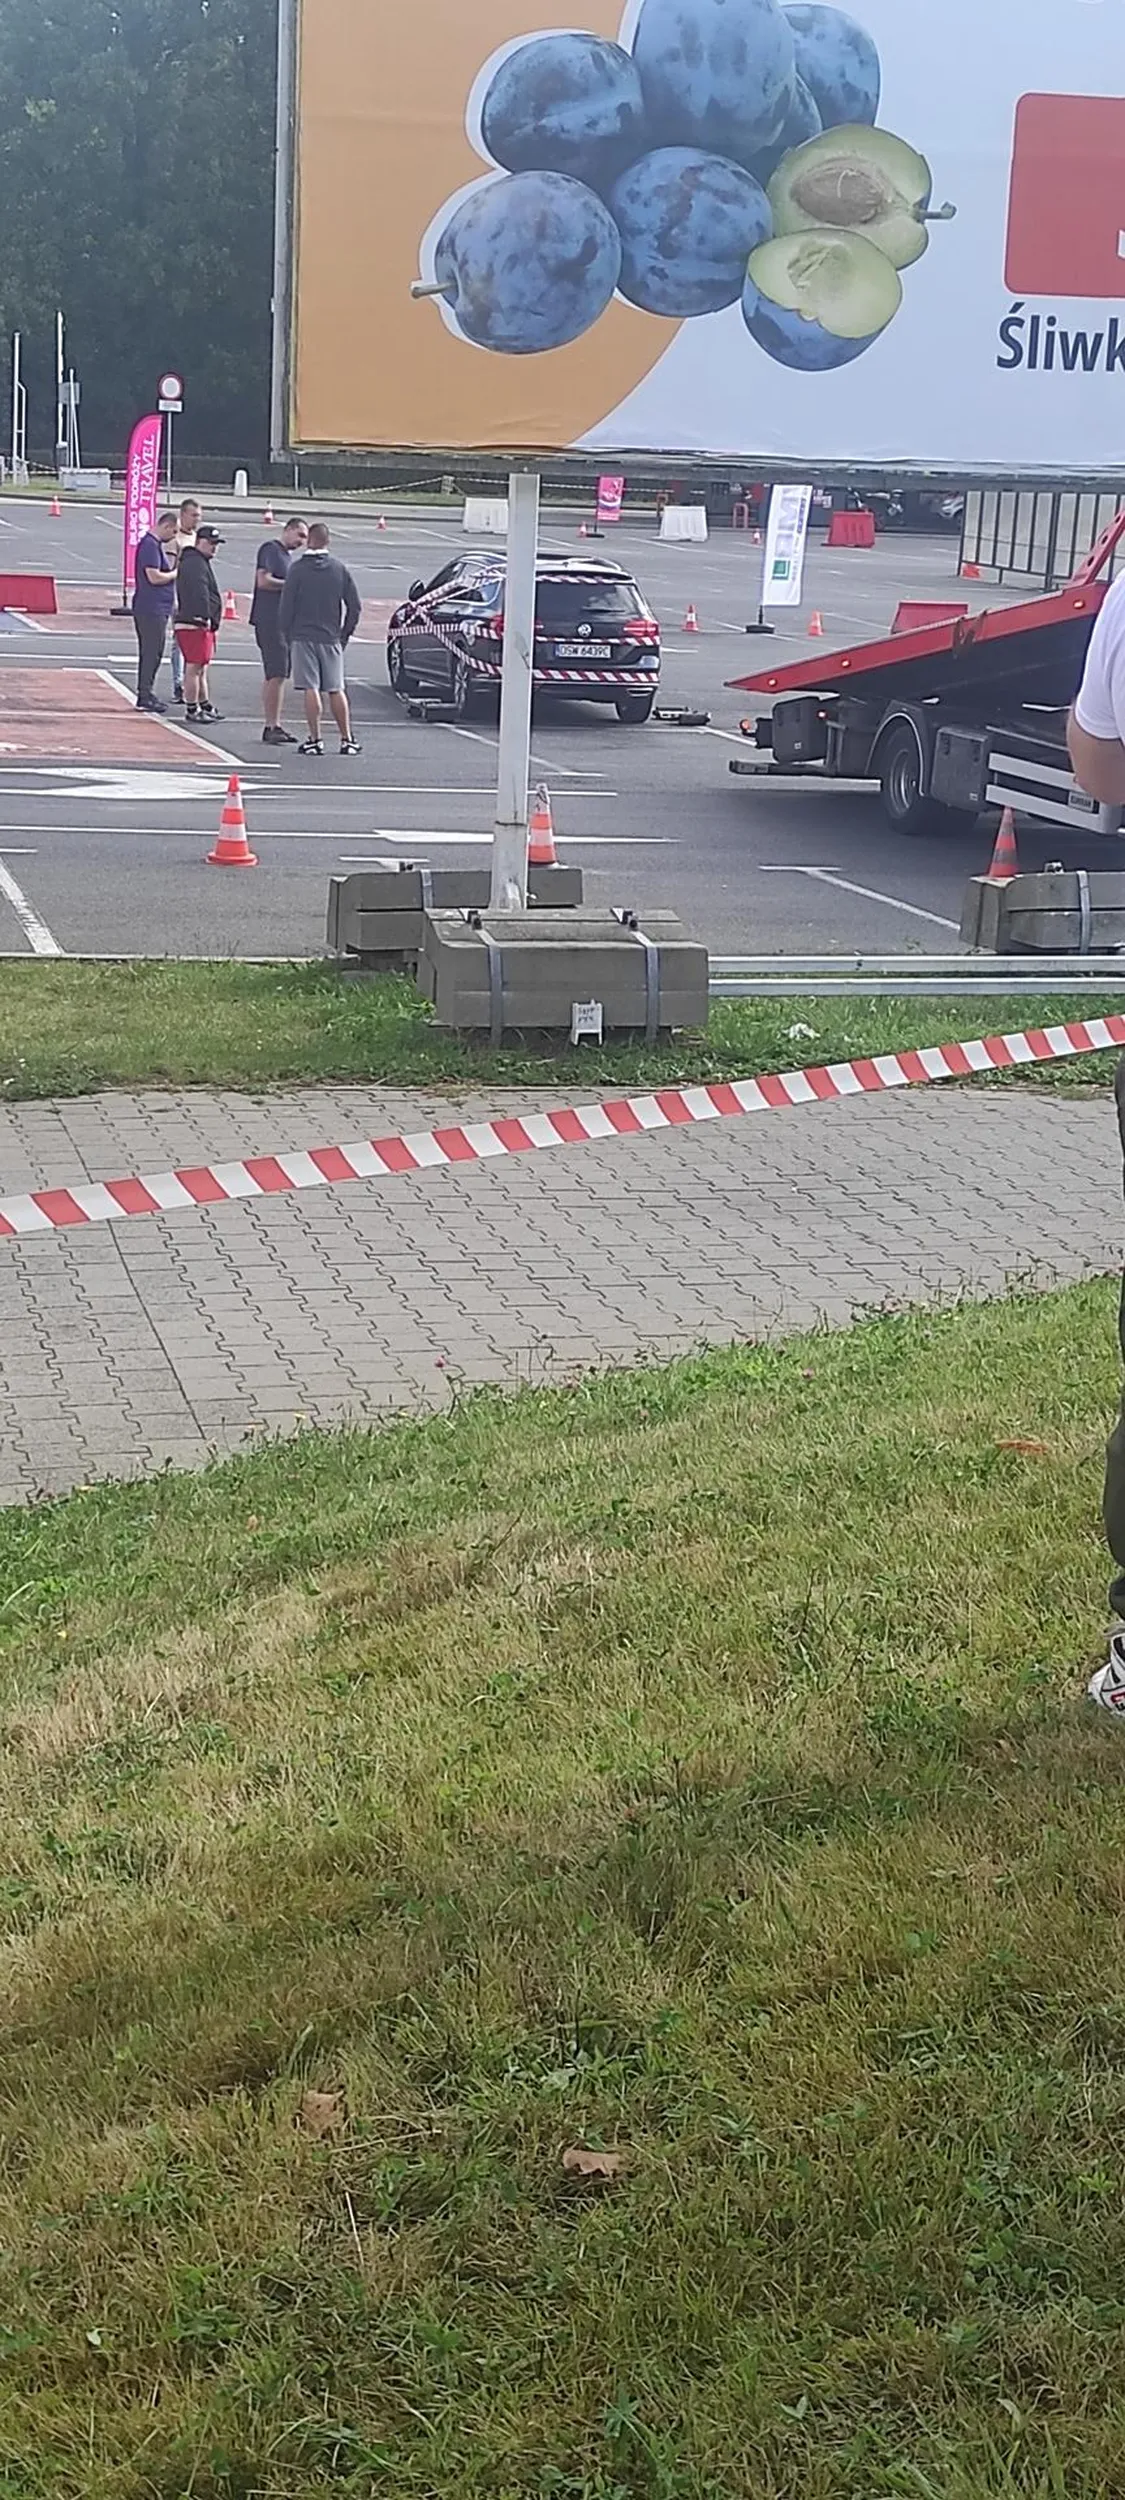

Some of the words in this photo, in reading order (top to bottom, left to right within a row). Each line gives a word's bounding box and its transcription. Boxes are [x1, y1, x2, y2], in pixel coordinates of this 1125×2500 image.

[997, 302, 1125, 372] Śliwk
[140, 434, 155, 501] TRAVEL
[129, 511, 138, 546] BIURO
